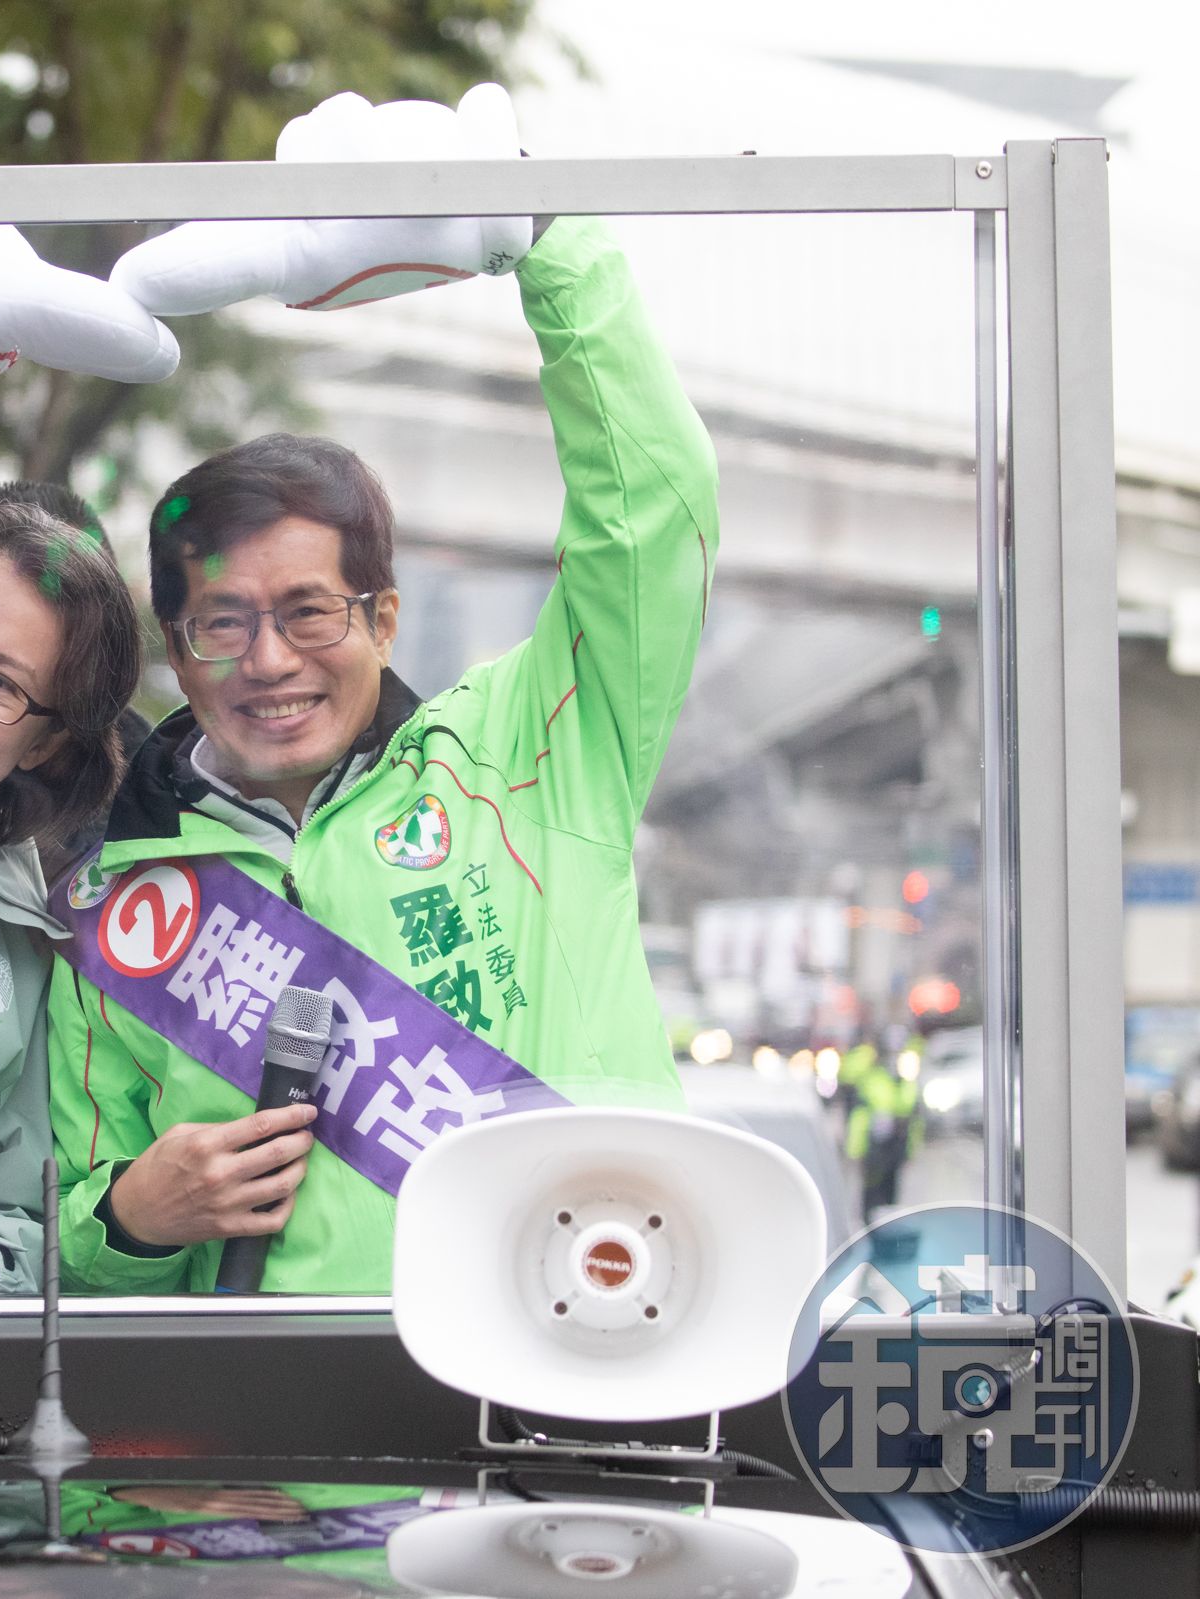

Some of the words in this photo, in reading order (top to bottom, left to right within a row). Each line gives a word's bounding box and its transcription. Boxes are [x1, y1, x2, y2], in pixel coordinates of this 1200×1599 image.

[389, 883, 504, 1050] 羅致
[462, 863, 528, 1020] 立法委員
